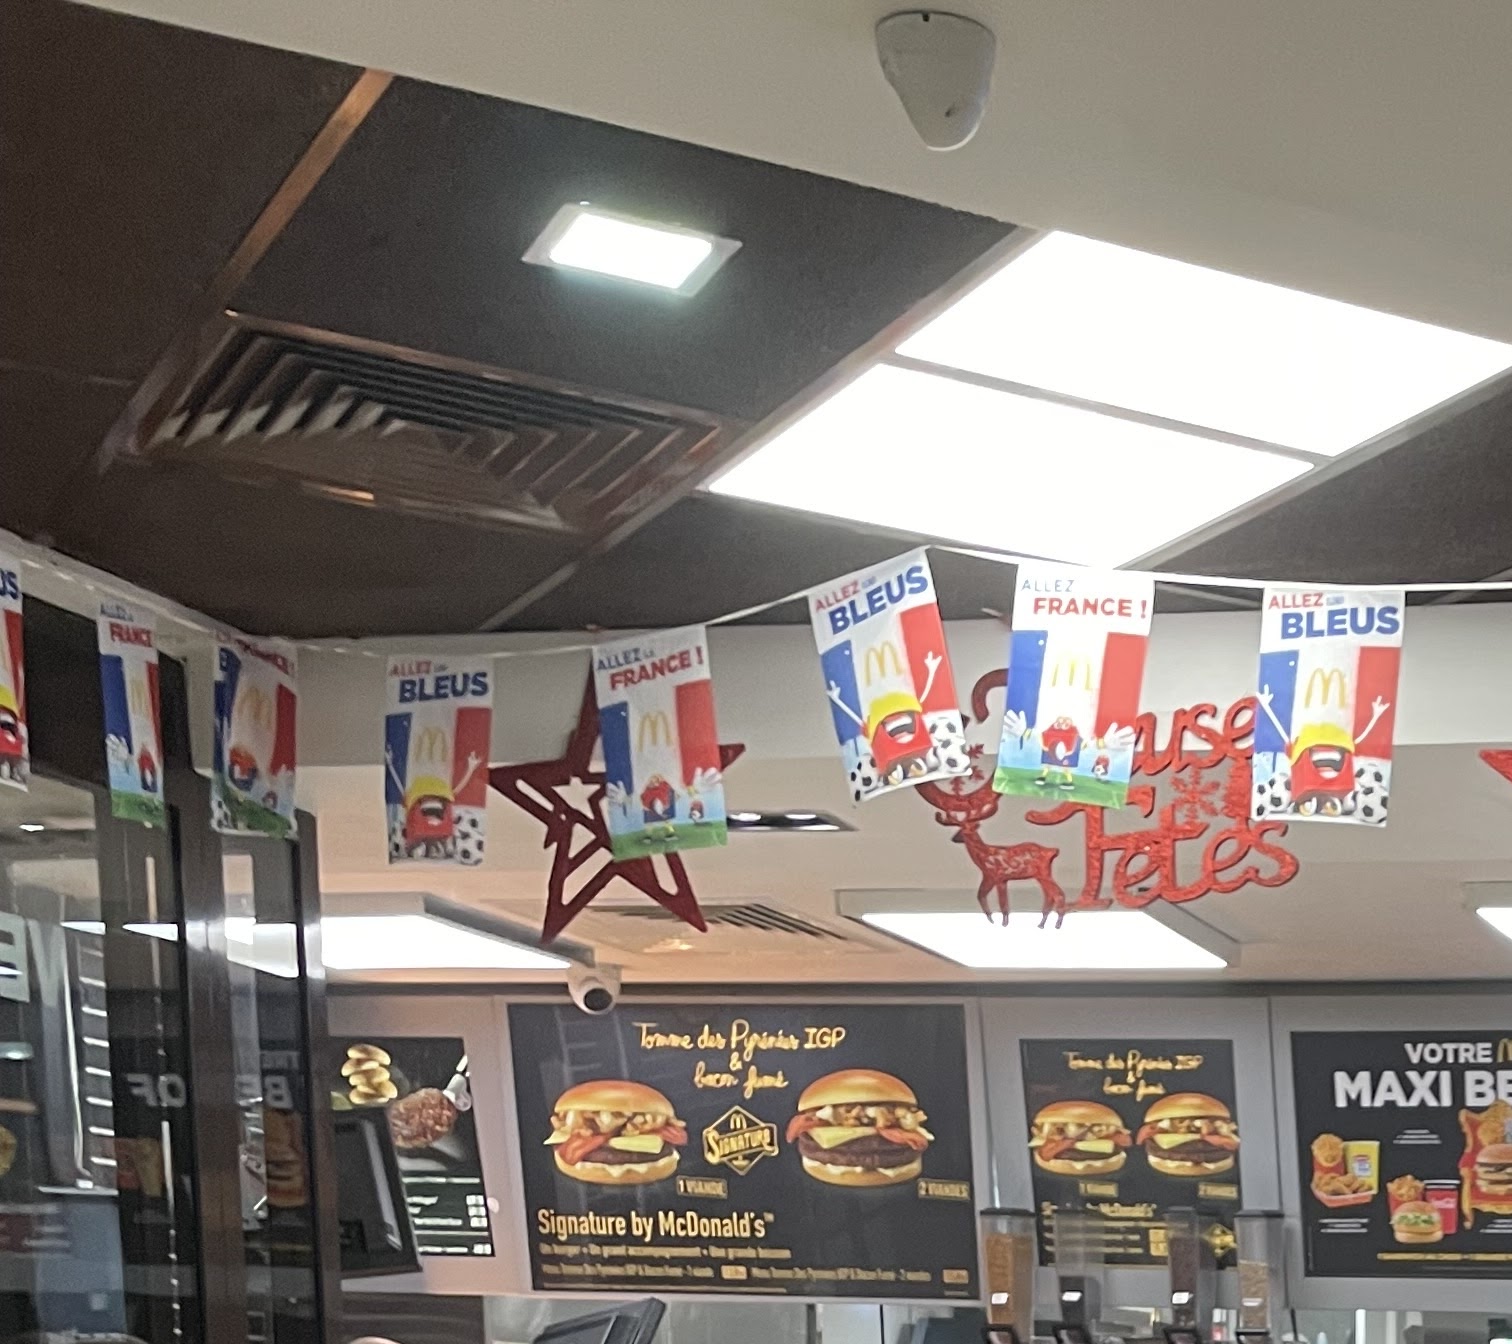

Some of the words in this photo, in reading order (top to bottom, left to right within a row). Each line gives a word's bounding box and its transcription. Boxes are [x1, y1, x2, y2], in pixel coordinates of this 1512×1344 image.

[815, 580, 860, 613] ALLEZ
[828, 565, 929, 635] BLEUS
[1021, 579, 1075, 593] ALLEZ
[1268, 592, 1324, 610] ALLEZ
[1033, 597, 1133, 617] FRANCE
[1281, 605, 1400, 640] BLEUS
[597, 648, 640, 671] ALLEZ
[609, 650, 692, 691] FRANCE
[399, 671, 489, 703] BLEUS
[803, 1026, 846, 1050] IGP
[1404, 1042, 1492, 1064] VOTRE
[1334, 1070, 1453, 1108] MAXI
[538, 1209, 626, 1241] Signature
[630, 1210, 654, 1242] by
[658, 1211, 766, 1238] McDonald's
